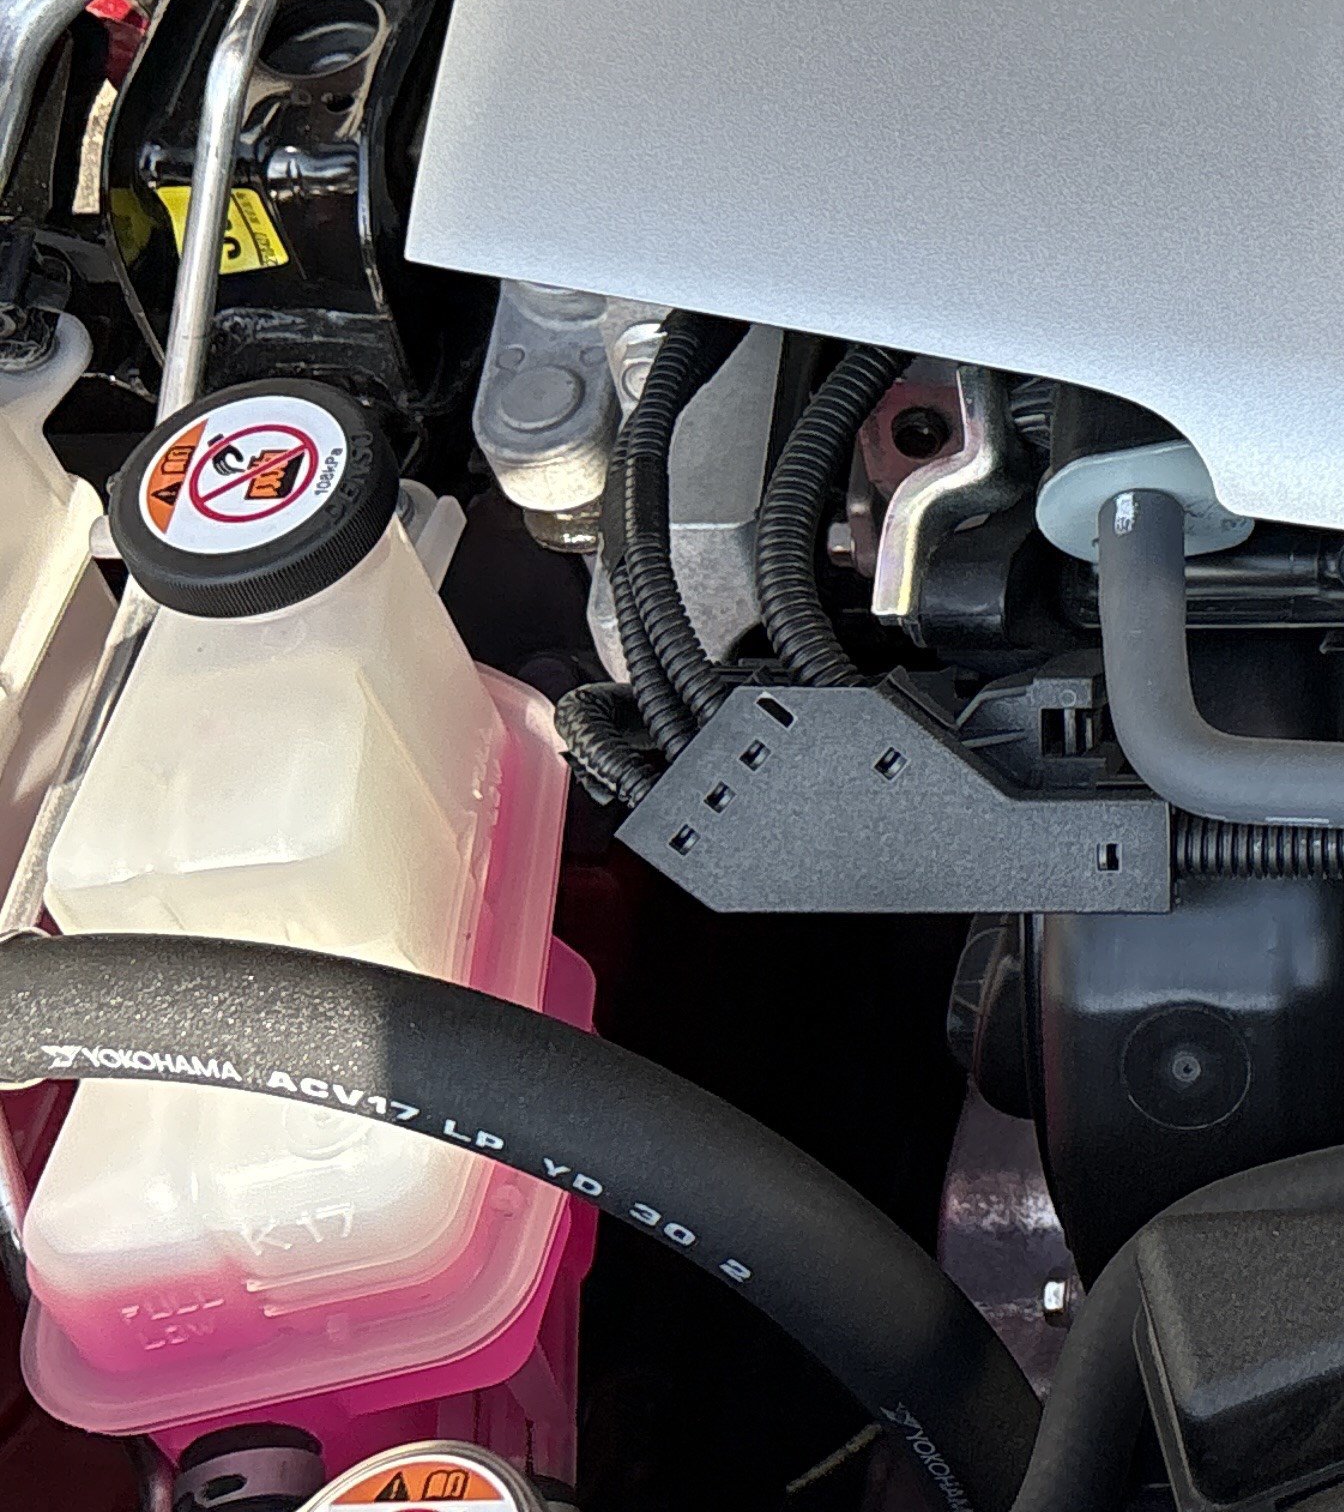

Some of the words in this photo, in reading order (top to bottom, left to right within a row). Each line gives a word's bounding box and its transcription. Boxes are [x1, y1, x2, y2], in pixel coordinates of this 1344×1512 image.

[314, 448, 344, 496] 108kPa
[81, 1046, 243, 1083] YOKOHAMA
[266, 1071, 421, 1121] ACV17
[443, 1119, 504, 1150] LP
[543, 1157, 603, 1197] YD
[629, 1202, 697, 1247] 30
[719, 1258, 751, 1284] 2
[239, 1202, 354, 1256] K17
